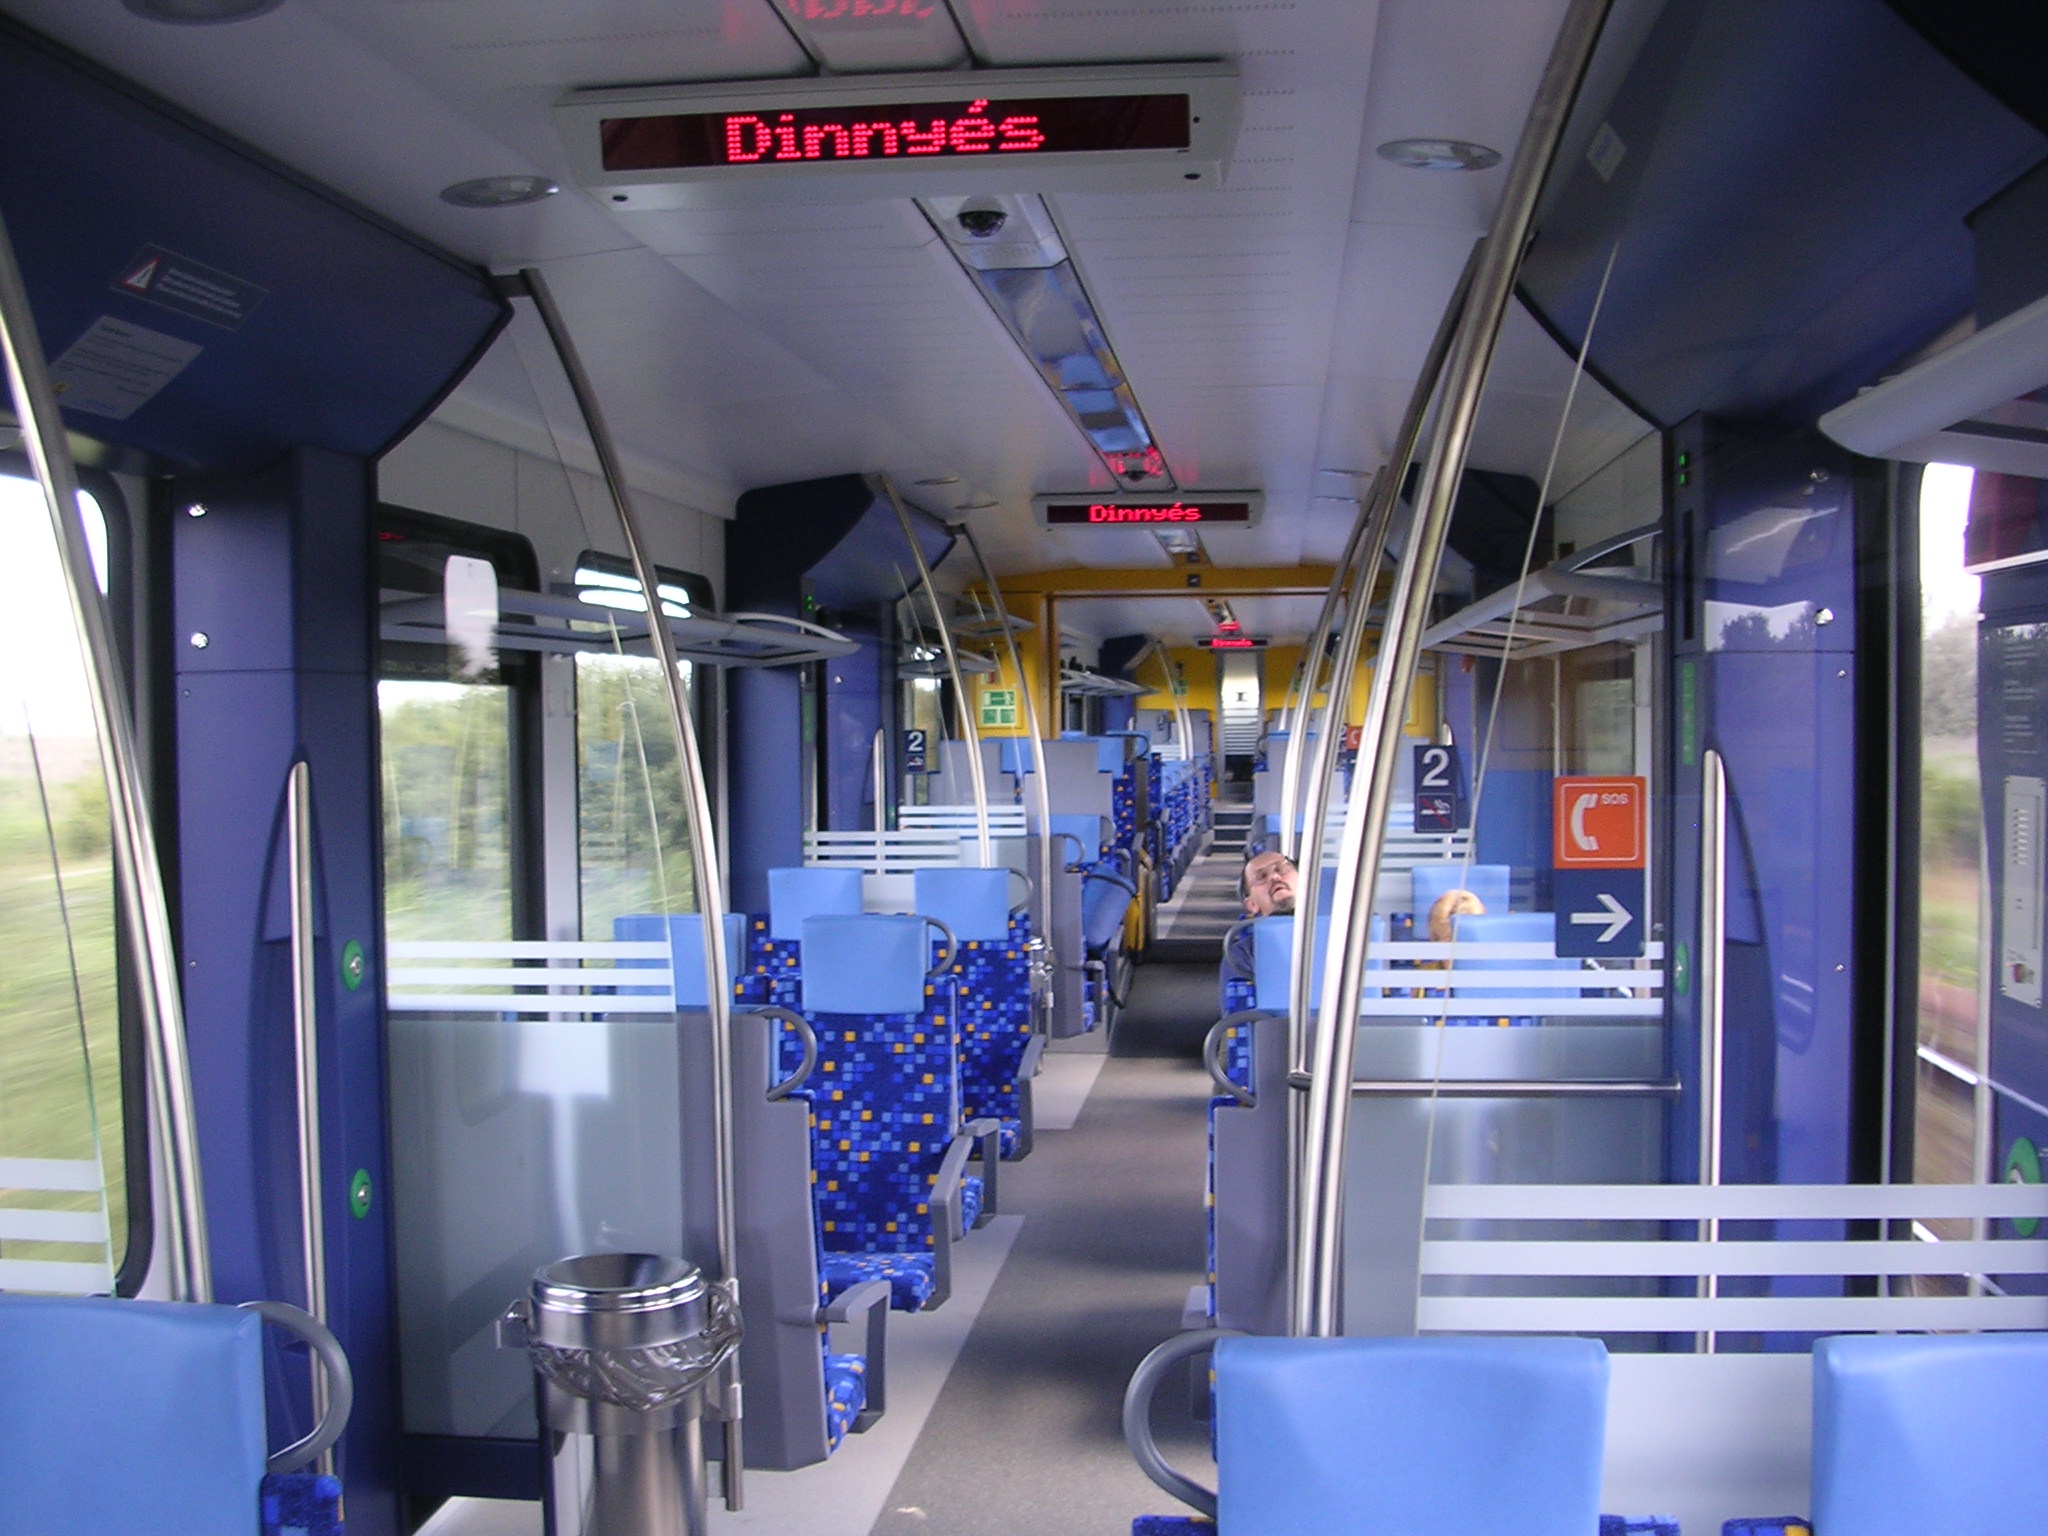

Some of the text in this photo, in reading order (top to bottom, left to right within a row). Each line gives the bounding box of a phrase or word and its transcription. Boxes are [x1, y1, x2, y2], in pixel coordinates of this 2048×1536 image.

[727, 99, 1045, 161] Dinnyés
[1089, 502, 1202, 523] Dinnyés
[908, 731, 923, 751] 2
[1422, 748, 1449, 786] 2
[1601, 793, 1629, 805] SOS
